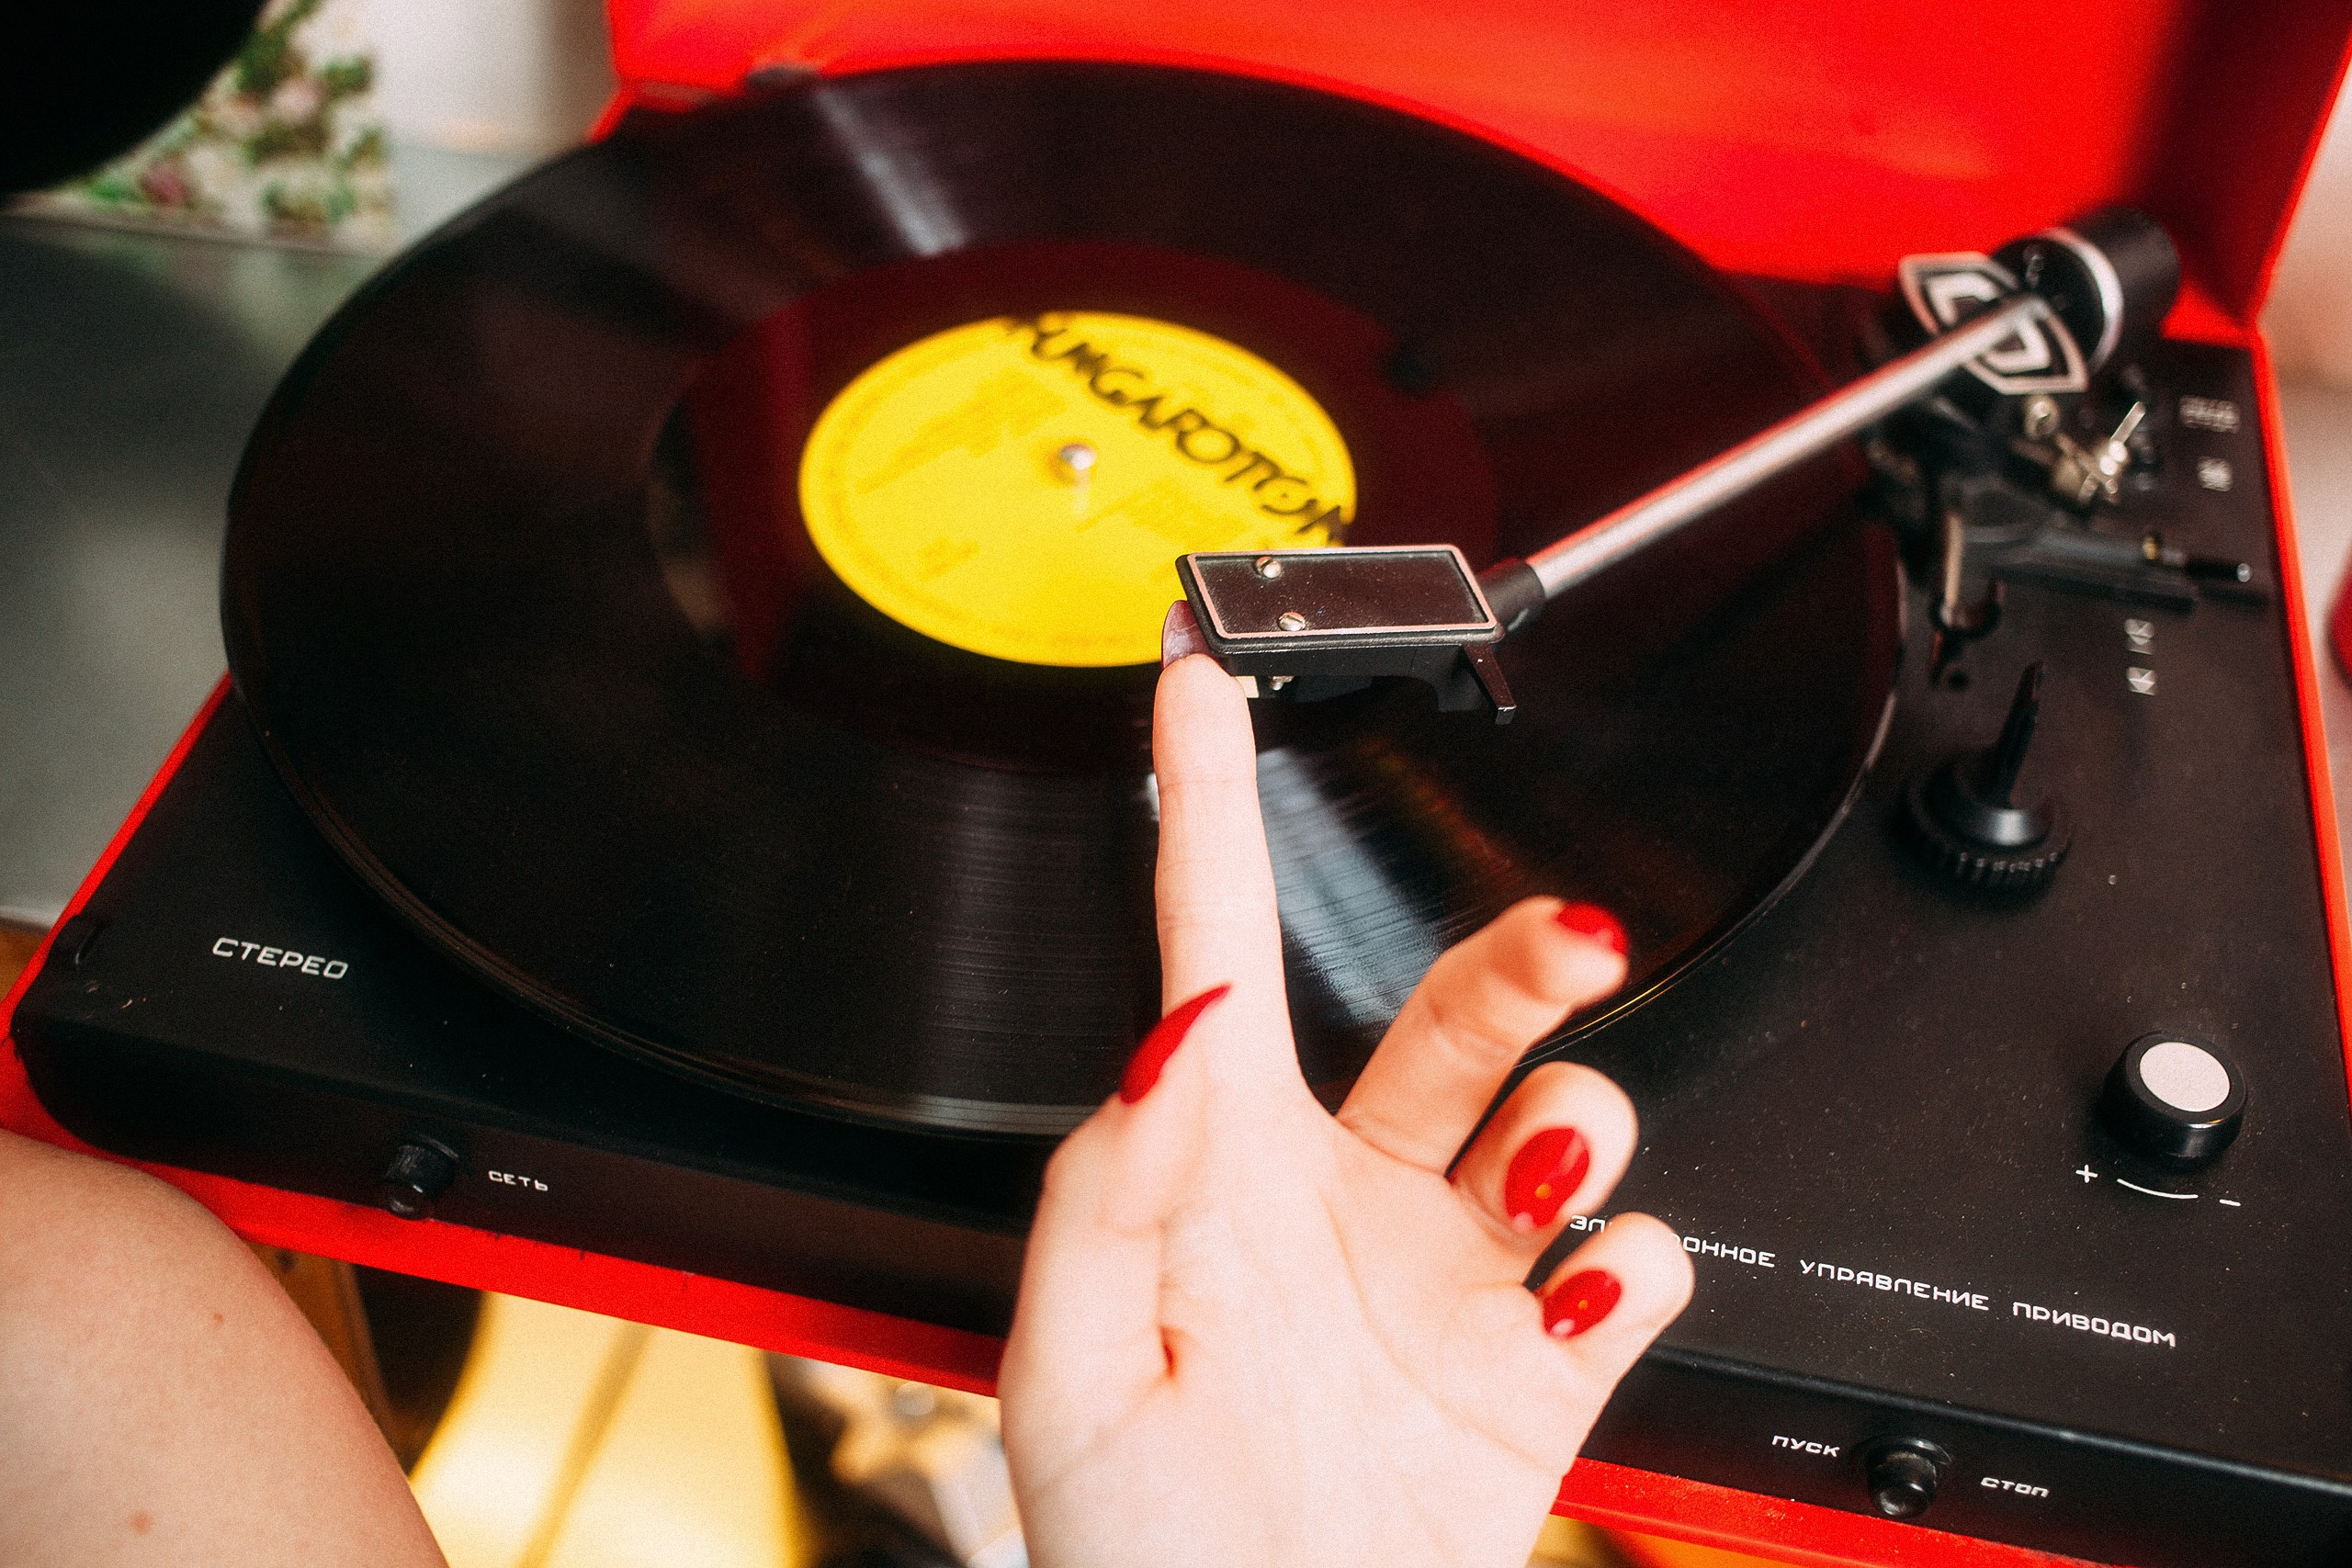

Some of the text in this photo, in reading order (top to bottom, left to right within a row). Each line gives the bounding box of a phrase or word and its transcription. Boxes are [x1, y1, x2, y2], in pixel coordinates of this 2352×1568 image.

[212, 937, 348, 979] СТЕРЕО
[488, 1170, 548, 1191] СЕТЬ
[1569, 1214, 2177, 1348] ЭЛОННОЕ УПРАВЛЕНИЕ ПРИВОДОМ
[1771, 1435, 1840, 1458] ПУСК
[1980, 1477, 2050, 1497] СТОП
